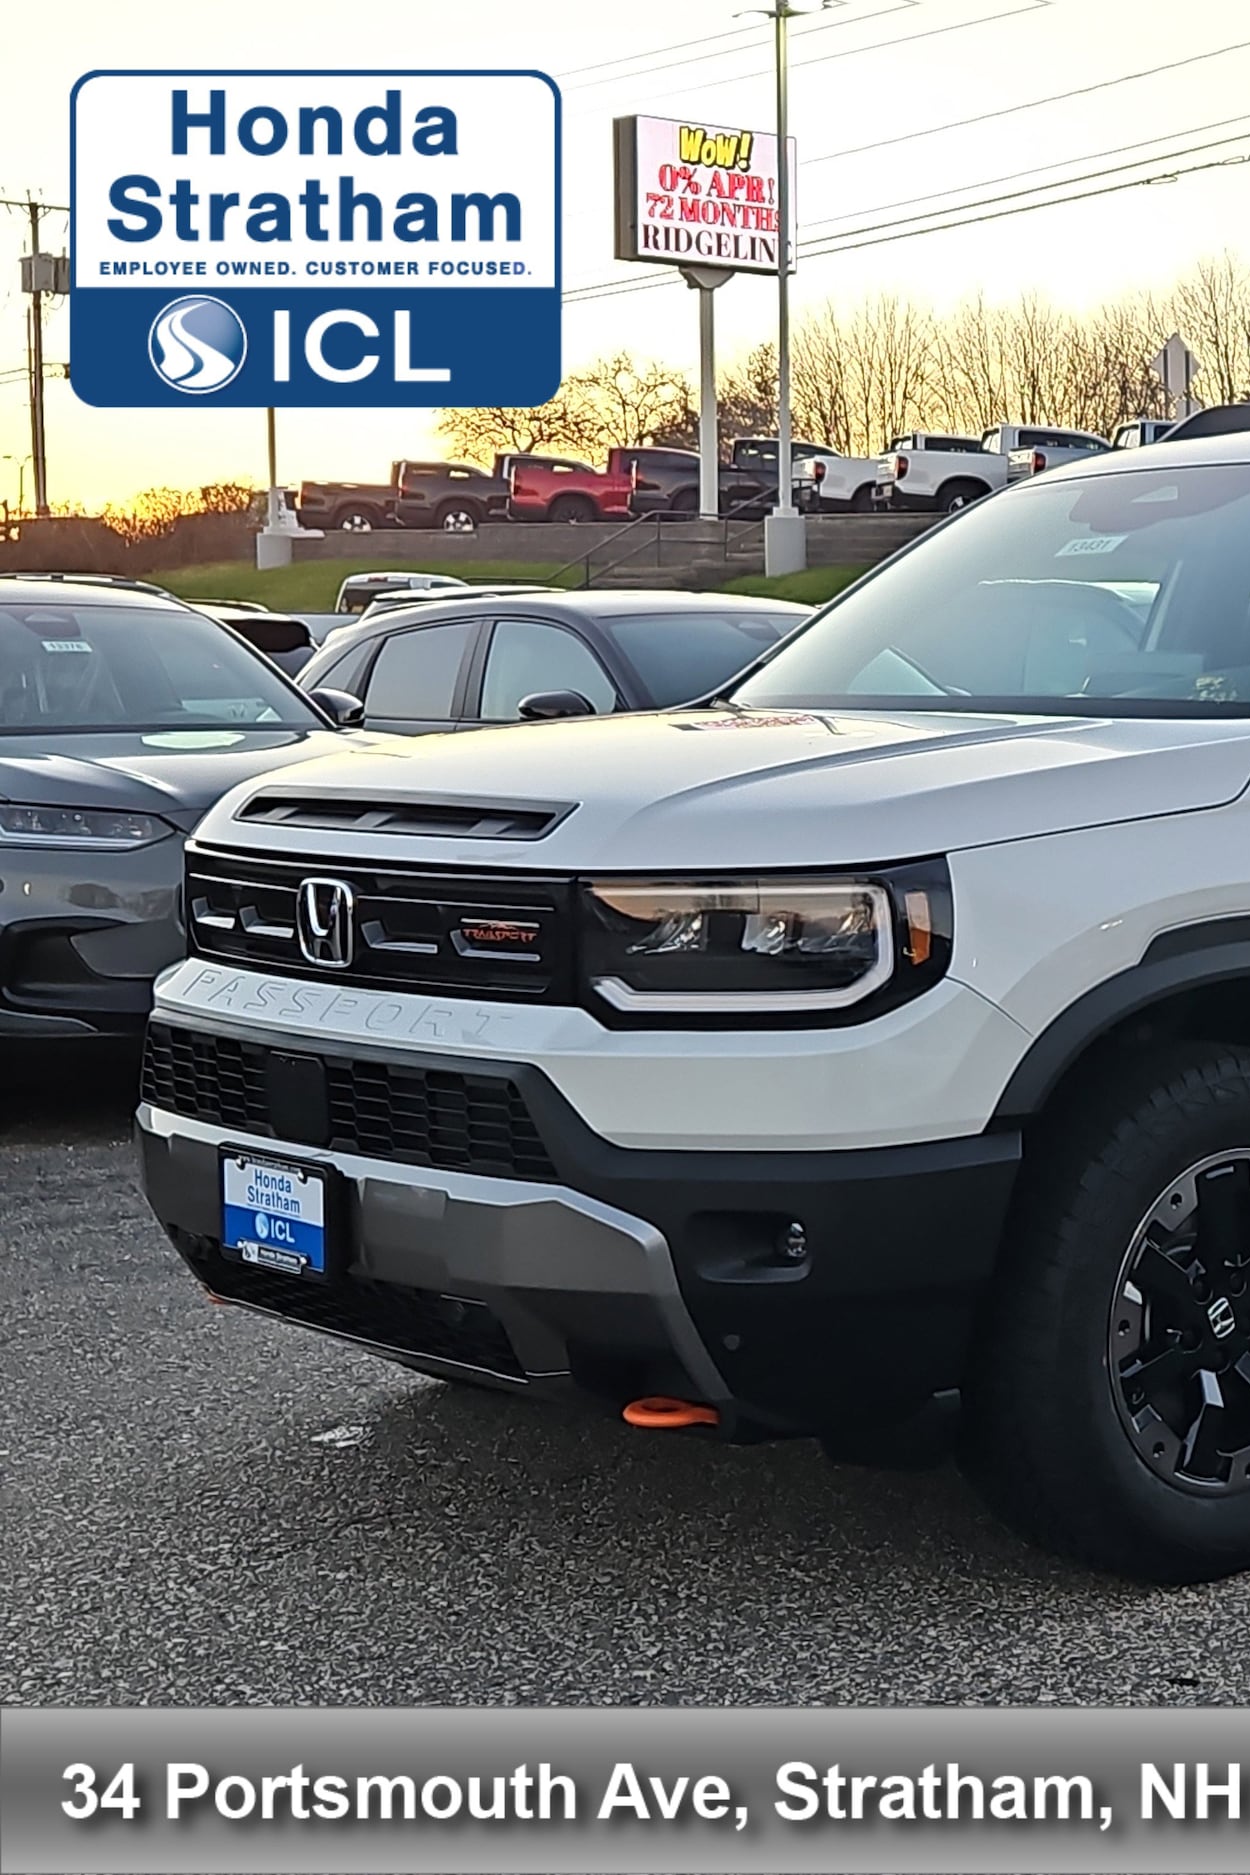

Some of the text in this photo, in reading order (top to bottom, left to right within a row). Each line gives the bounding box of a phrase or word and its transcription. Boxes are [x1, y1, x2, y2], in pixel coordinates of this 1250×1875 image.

[658, 164, 775, 205] 0% APR!
[646, 192, 674, 219] 72
[182, 967, 514, 1038] PASSPORT
[254, 1169, 292, 1193] Honda
[247, 1185, 301, 1214] Stratham
[270, 1218, 296, 1243] ICL
